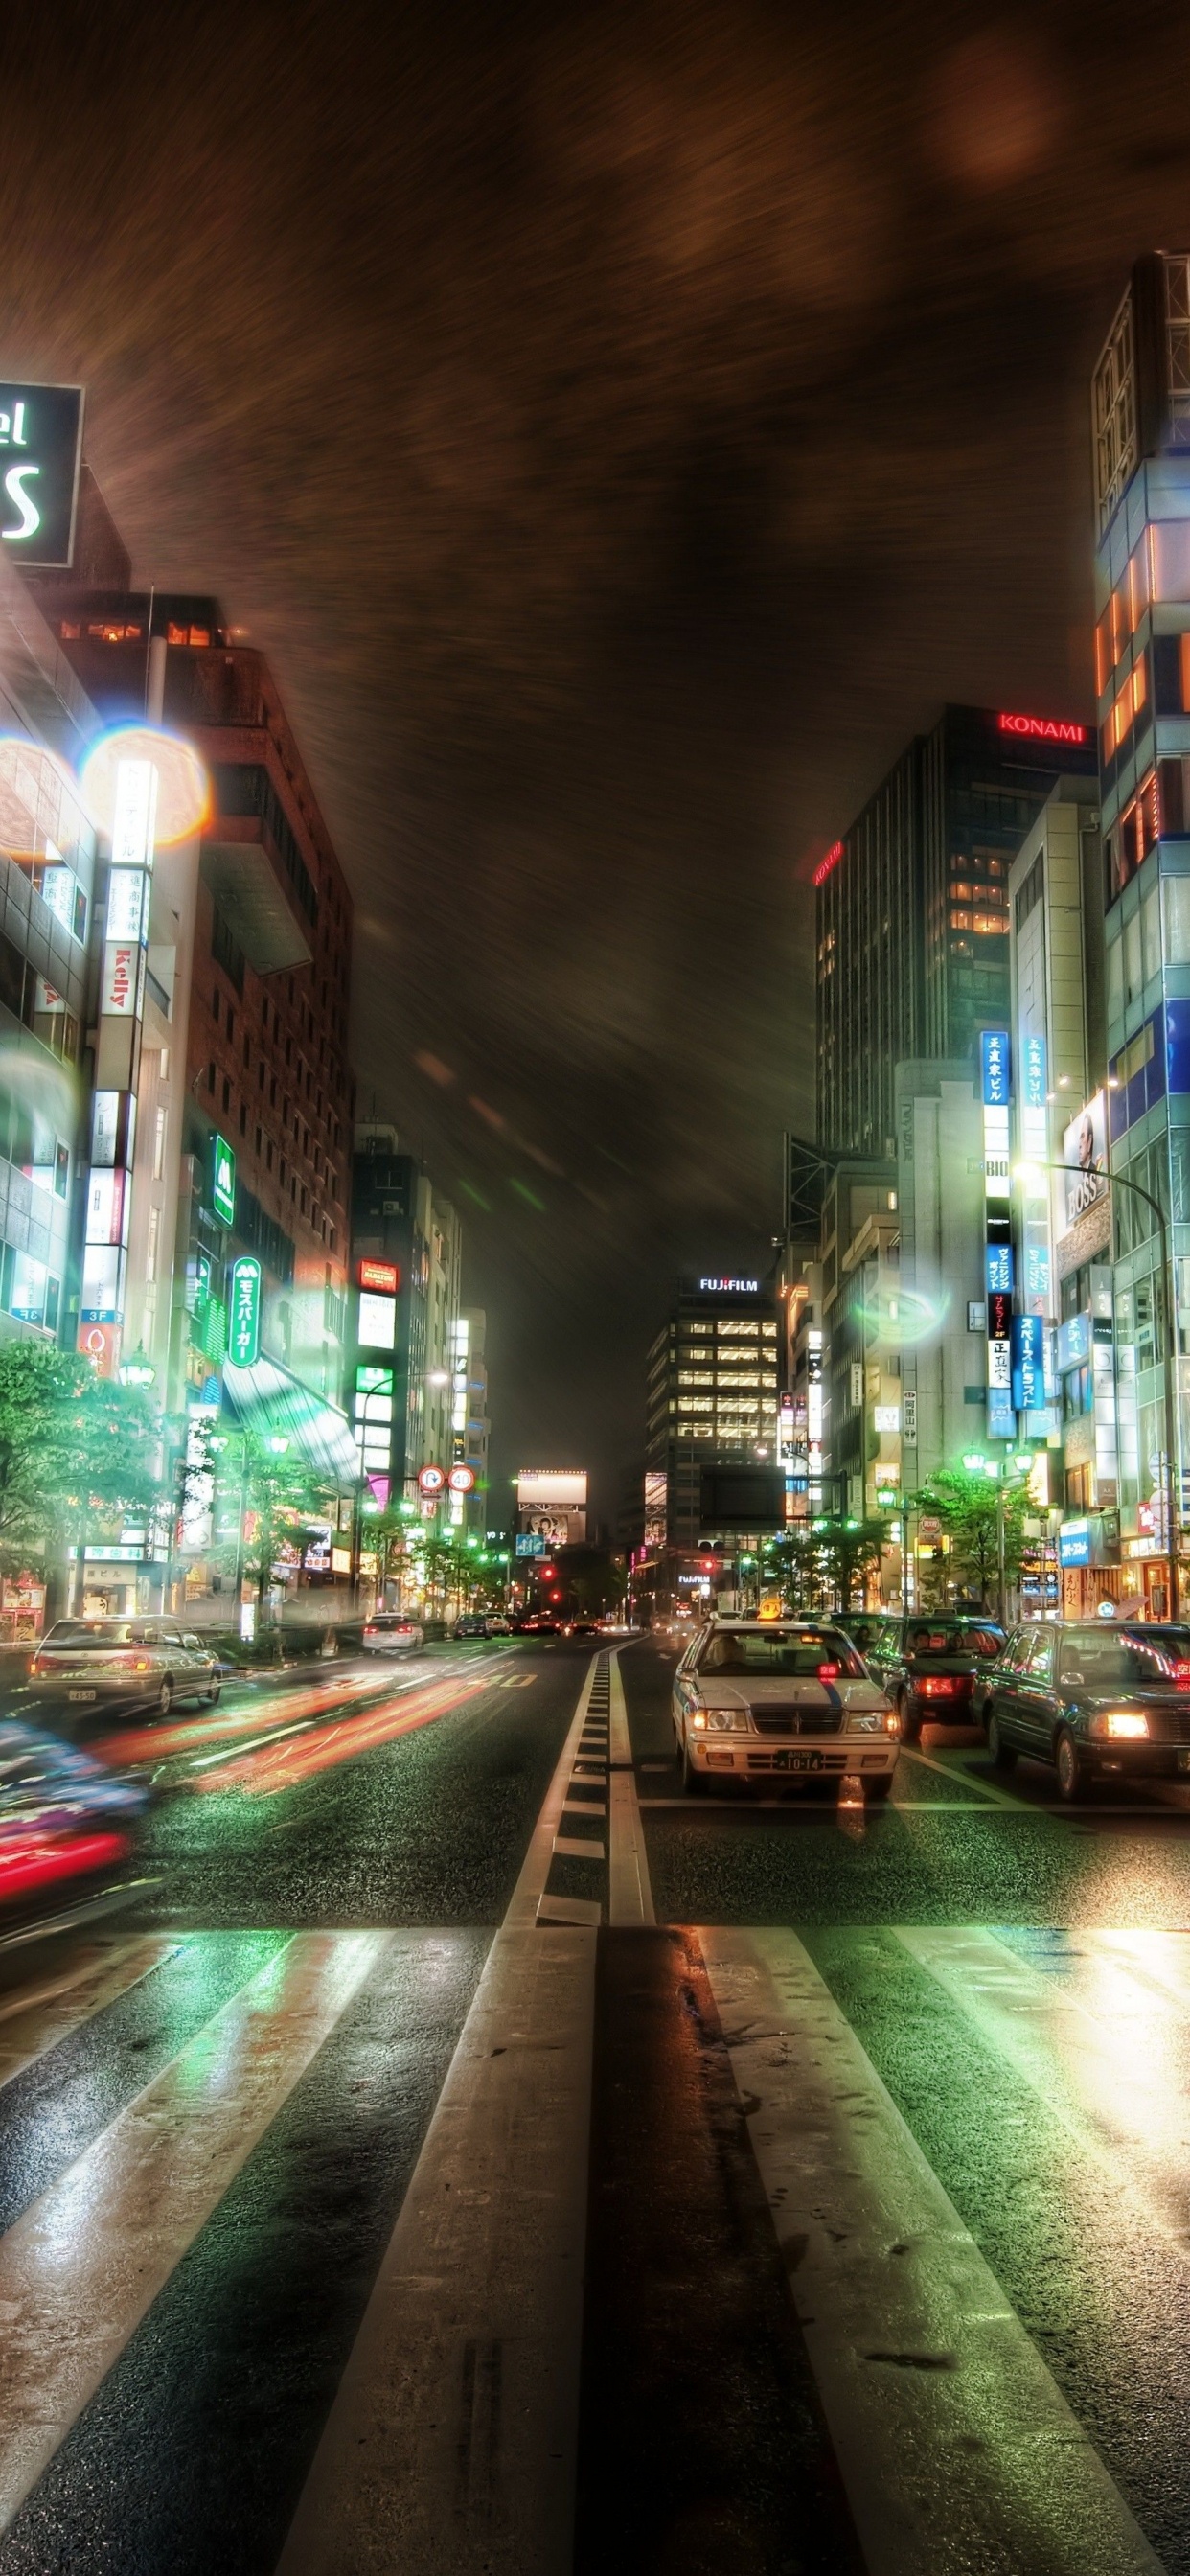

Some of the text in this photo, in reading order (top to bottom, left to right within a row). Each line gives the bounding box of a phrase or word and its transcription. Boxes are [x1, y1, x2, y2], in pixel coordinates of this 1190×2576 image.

[2, 466, 40, 539] S
[1001, 715, 1083, 742] KONAMI
[110, 950, 131, 1008] Kelly
[1068, 1171, 1097, 1221] BOSS
[700, 1278, 758, 1292] FUJIFILM
[89, 1311, 107, 1322] 3F
[237, 1279, 254, 1359] モスバーガー
[1021, 1318, 1035, 1407] スペーストラスト
[904, 1400, 915, 1425] 阿里山
[453, 1473, 469, 1485] 40
[1178, 1664, 1190, 1675] 空
